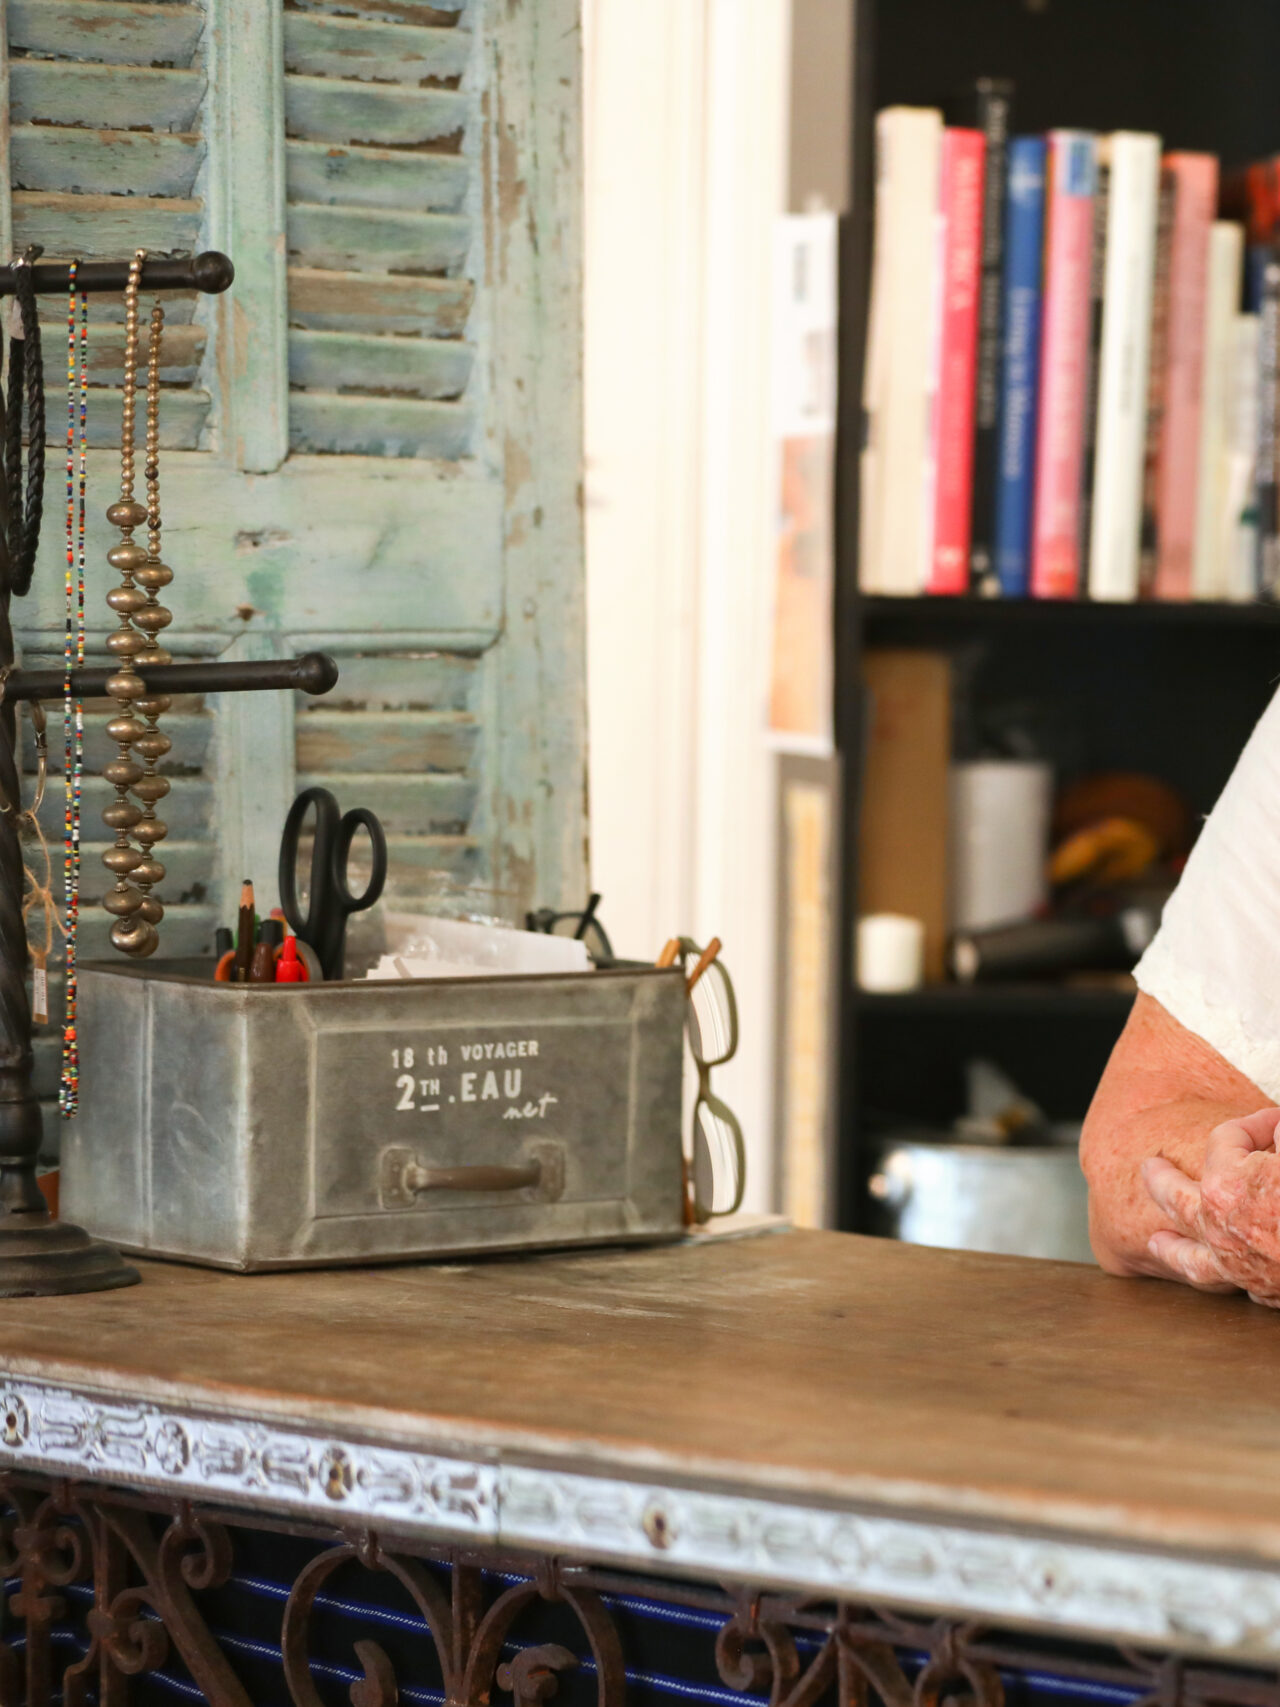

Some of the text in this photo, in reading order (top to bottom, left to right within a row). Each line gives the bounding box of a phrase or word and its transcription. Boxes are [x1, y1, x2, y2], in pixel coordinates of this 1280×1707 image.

[391, 1040, 539, 1069] 18 th VOYAGER
[502, 1091, 558, 1119] net
